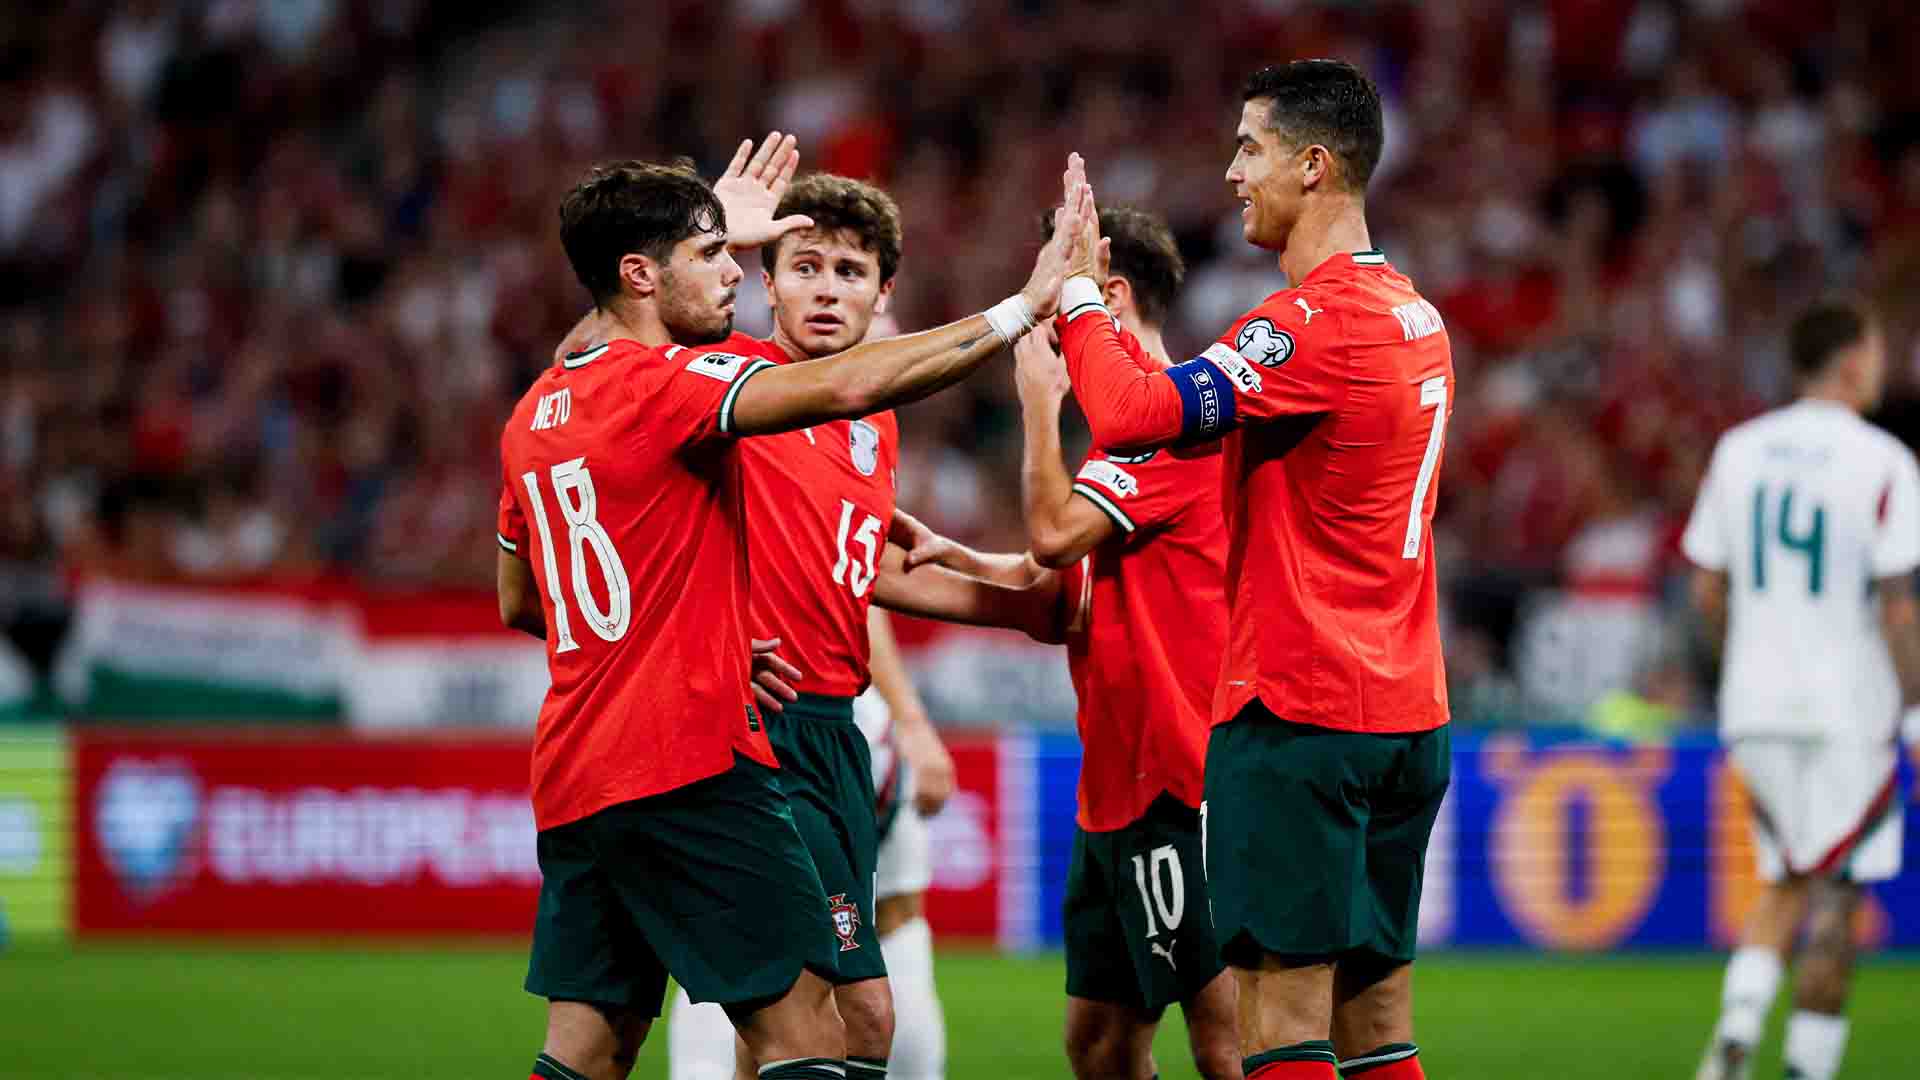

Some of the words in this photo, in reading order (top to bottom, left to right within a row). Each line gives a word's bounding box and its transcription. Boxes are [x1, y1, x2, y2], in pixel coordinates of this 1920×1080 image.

[530, 387, 571, 431] NETO
[1401, 376, 1448, 559] 7
[522, 456, 631, 653] 18
[832, 498, 881, 597] 15
[1753, 482, 1823, 594] 14
[1131, 844, 1184, 938] 10
